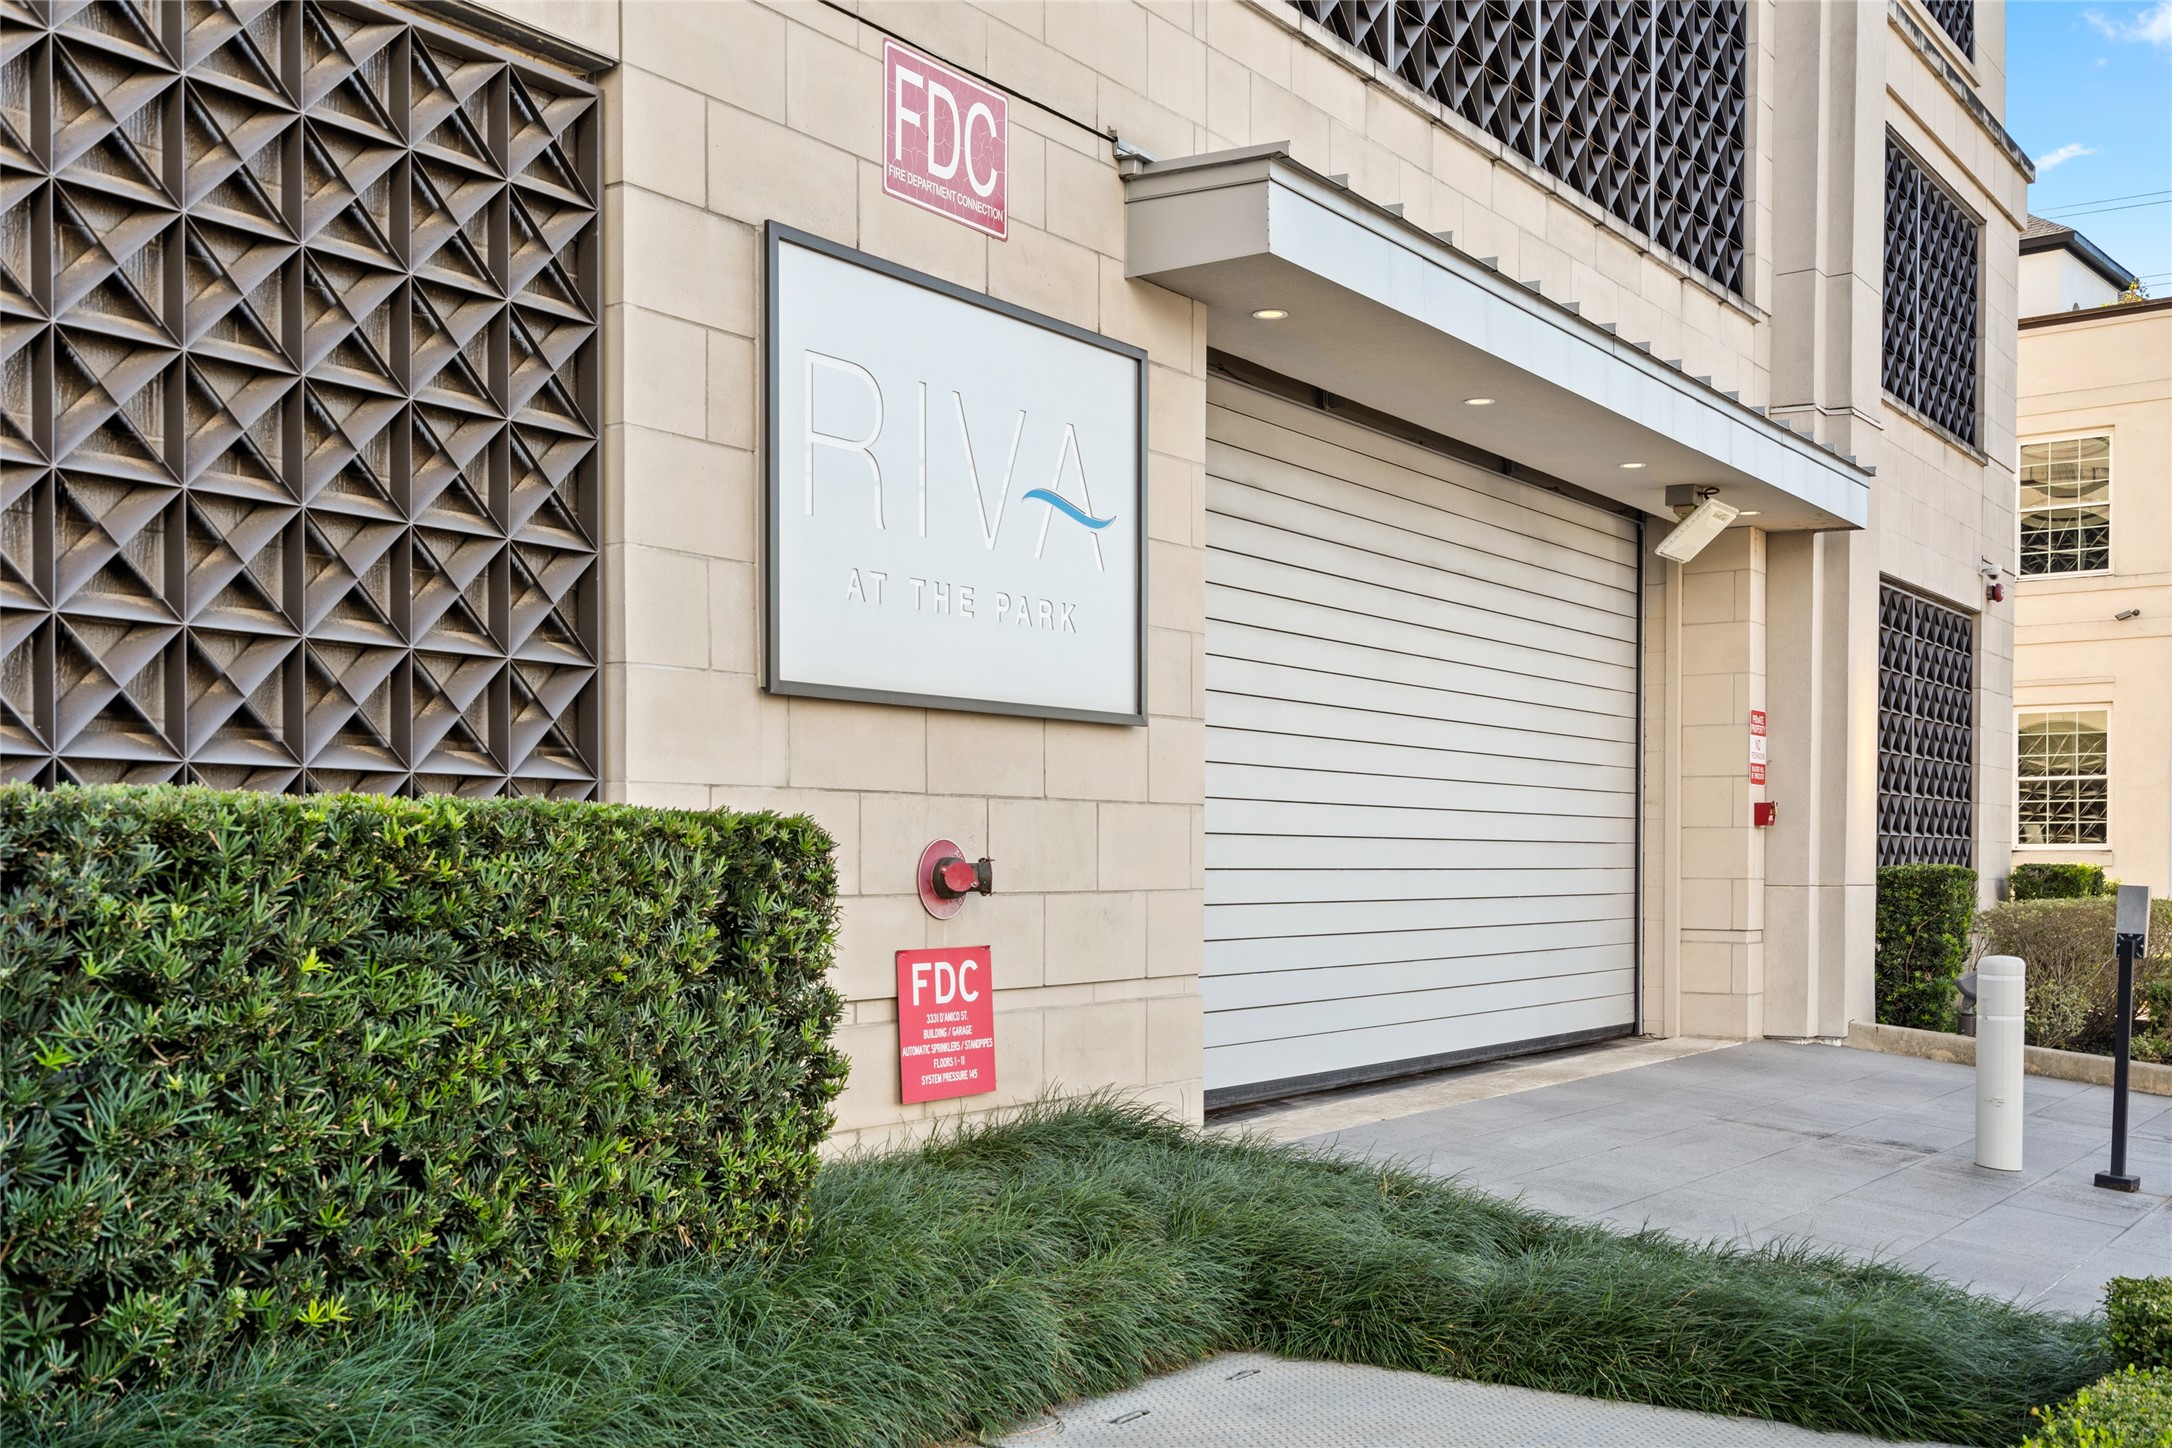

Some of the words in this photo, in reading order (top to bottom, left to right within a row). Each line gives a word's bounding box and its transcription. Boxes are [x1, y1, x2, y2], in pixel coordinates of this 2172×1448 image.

[895, 63, 998, 197] FDC
[888, 164, 906, 182] FIRE
[907, 173, 957, 202] DEPARTMENT
[957, 193, 1004, 221] CONNECTION
[804, 347, 1113, 572] RIVA
[846, 567, 888, 606] AT
[908, 576, 975, 619] THE
[995, 590, 1077, 634] PARK
[912, 959, 979, 1006] FDC
[923, 1027, 947, 1040] BUILDING
[952, 1025, 973, 1036] GARAGE
[926, 1013, 939, 1024] 3331
[939, 1011, 960, 1023] D'AMICO
[960, 1010, 969, 1021] ST.
[902, 1044, 931, 1057] AUTOMATIC
[931, 1041, 961, 1054] SPRINKLERS
[964, 1038, 993, 1050] STANDPIPES
[933, 1057, 954, 1069] FLOORS
[921, 1073, 942, 1086] SYSTEM
[942, 1071, 968, 1083] PRESSURE
[968, 1069, 978, 1080] 145
